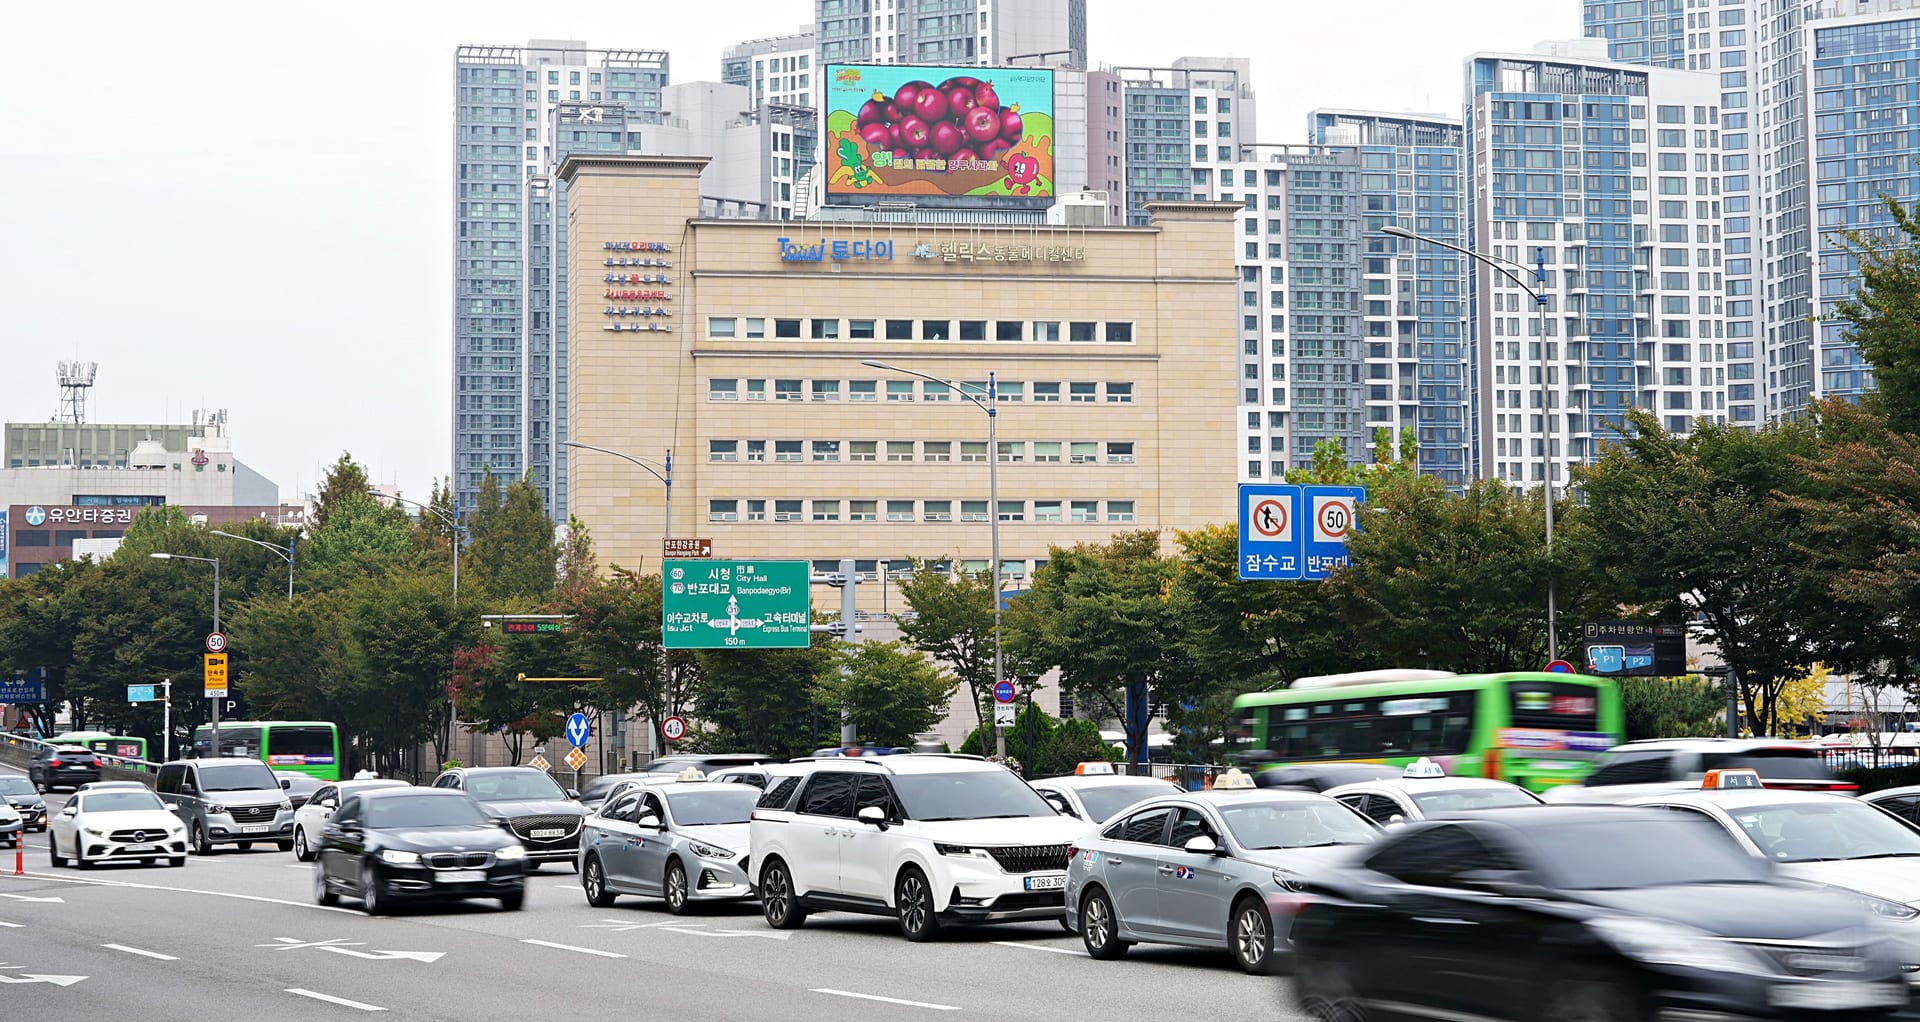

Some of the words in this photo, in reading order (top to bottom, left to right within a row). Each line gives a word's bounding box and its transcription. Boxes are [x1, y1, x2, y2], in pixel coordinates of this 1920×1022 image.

[830, 239, 893, 261] 토다이
[941, 241, 992, 262] 헬릭스
[994, 246, 1087, 262] 동물메디컬센터
[49, 508, 131, 523] 유안타증권
[1327, 511, 1344, 528] 50
[1246, 555, 1296, 572] 잠수교
[1307, 556, 1353, 572] 반포대
[708, 568, 730, 580] 시청
[736, 575, 750, 583] City
[687, 583, 730, 595] 반포대교
[667, 613, 708, 624] 이수교차로
[764, 612, 806, 624] 고속터미널
[1587, 624, 1595, 635] P
[1599, 624, 1653, 635] 주차현황안내
[210, 638, 222, 647] 50
[226, 701, 236, 712] P
[1729, 775, 1755, 785] 서울
